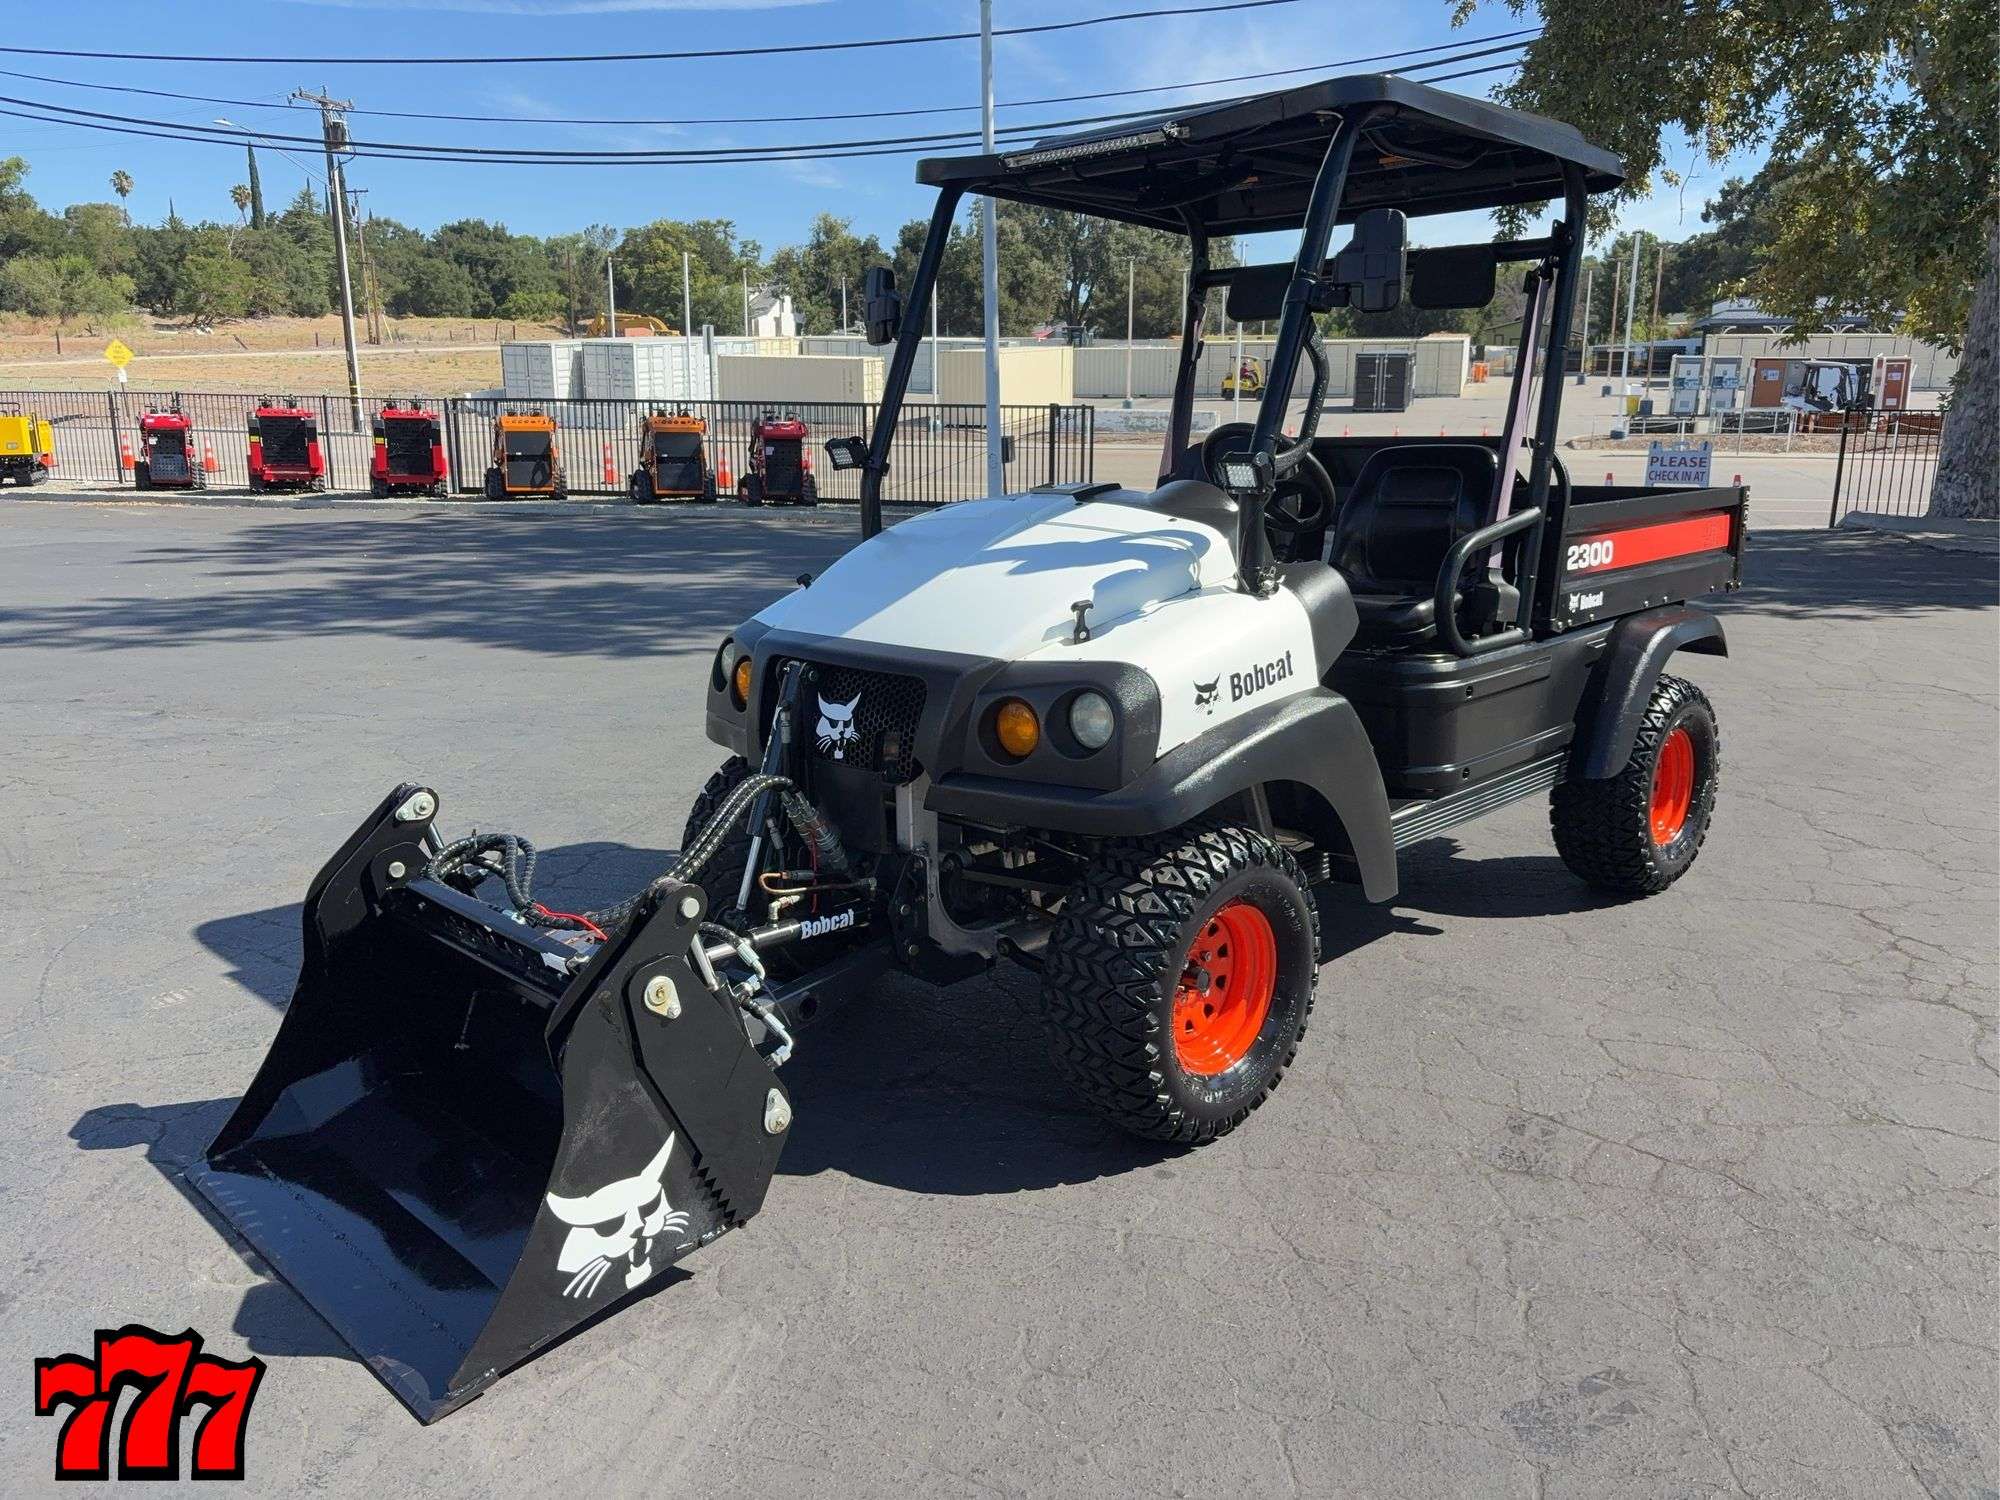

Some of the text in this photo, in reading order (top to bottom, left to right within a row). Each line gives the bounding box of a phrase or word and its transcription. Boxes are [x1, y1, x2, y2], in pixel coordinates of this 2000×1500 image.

[1648, 470, 1706, 482] CHECK IN AT
[1650, 456, 1708, 468] PLEASE
[1567, 540, 1614, 571] 2300
[1230, 650, 1293, 702] Bobcat
[801, 908, 855, 940] Bobcat
